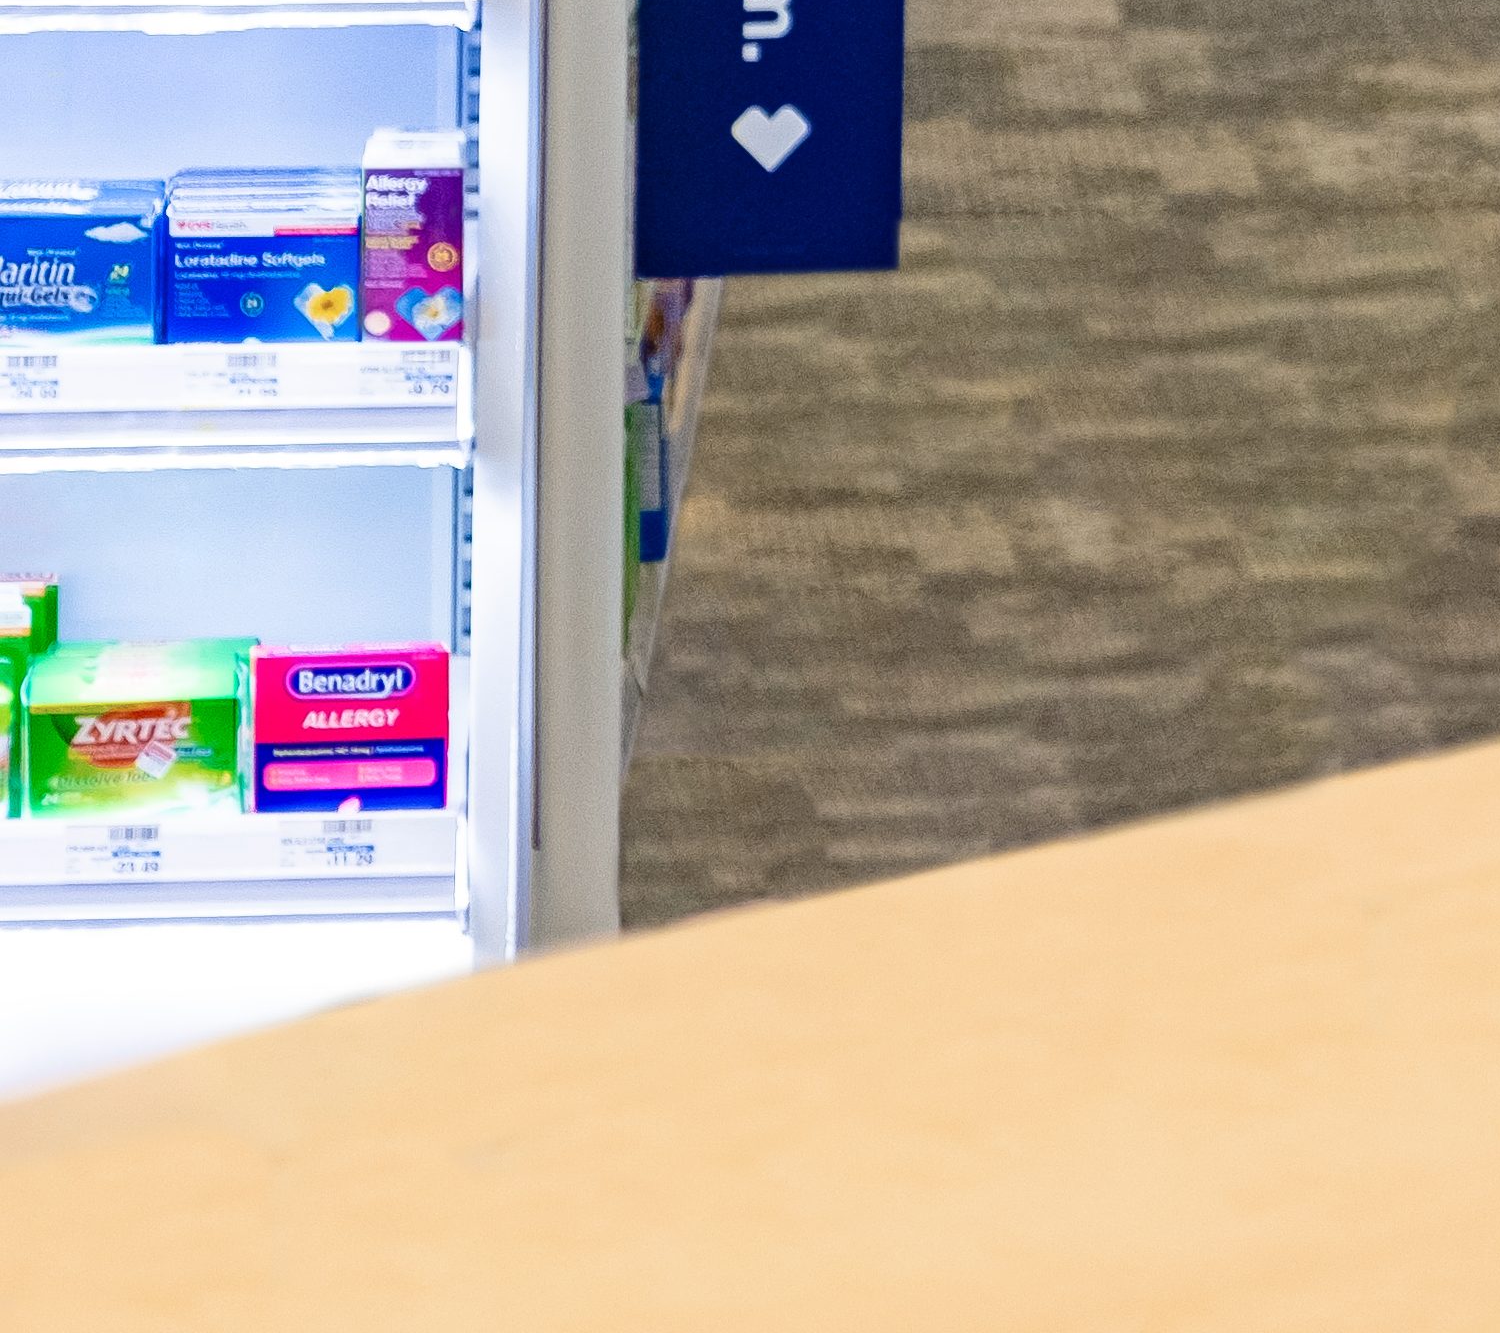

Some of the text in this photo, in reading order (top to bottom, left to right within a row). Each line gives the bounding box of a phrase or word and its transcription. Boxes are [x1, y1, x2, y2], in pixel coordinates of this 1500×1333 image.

[298, 667, 404, 697] Benadryl
[71, 713, 192, 745] ZYRTEC
[302, 707, 400, 730] ALLERGY
